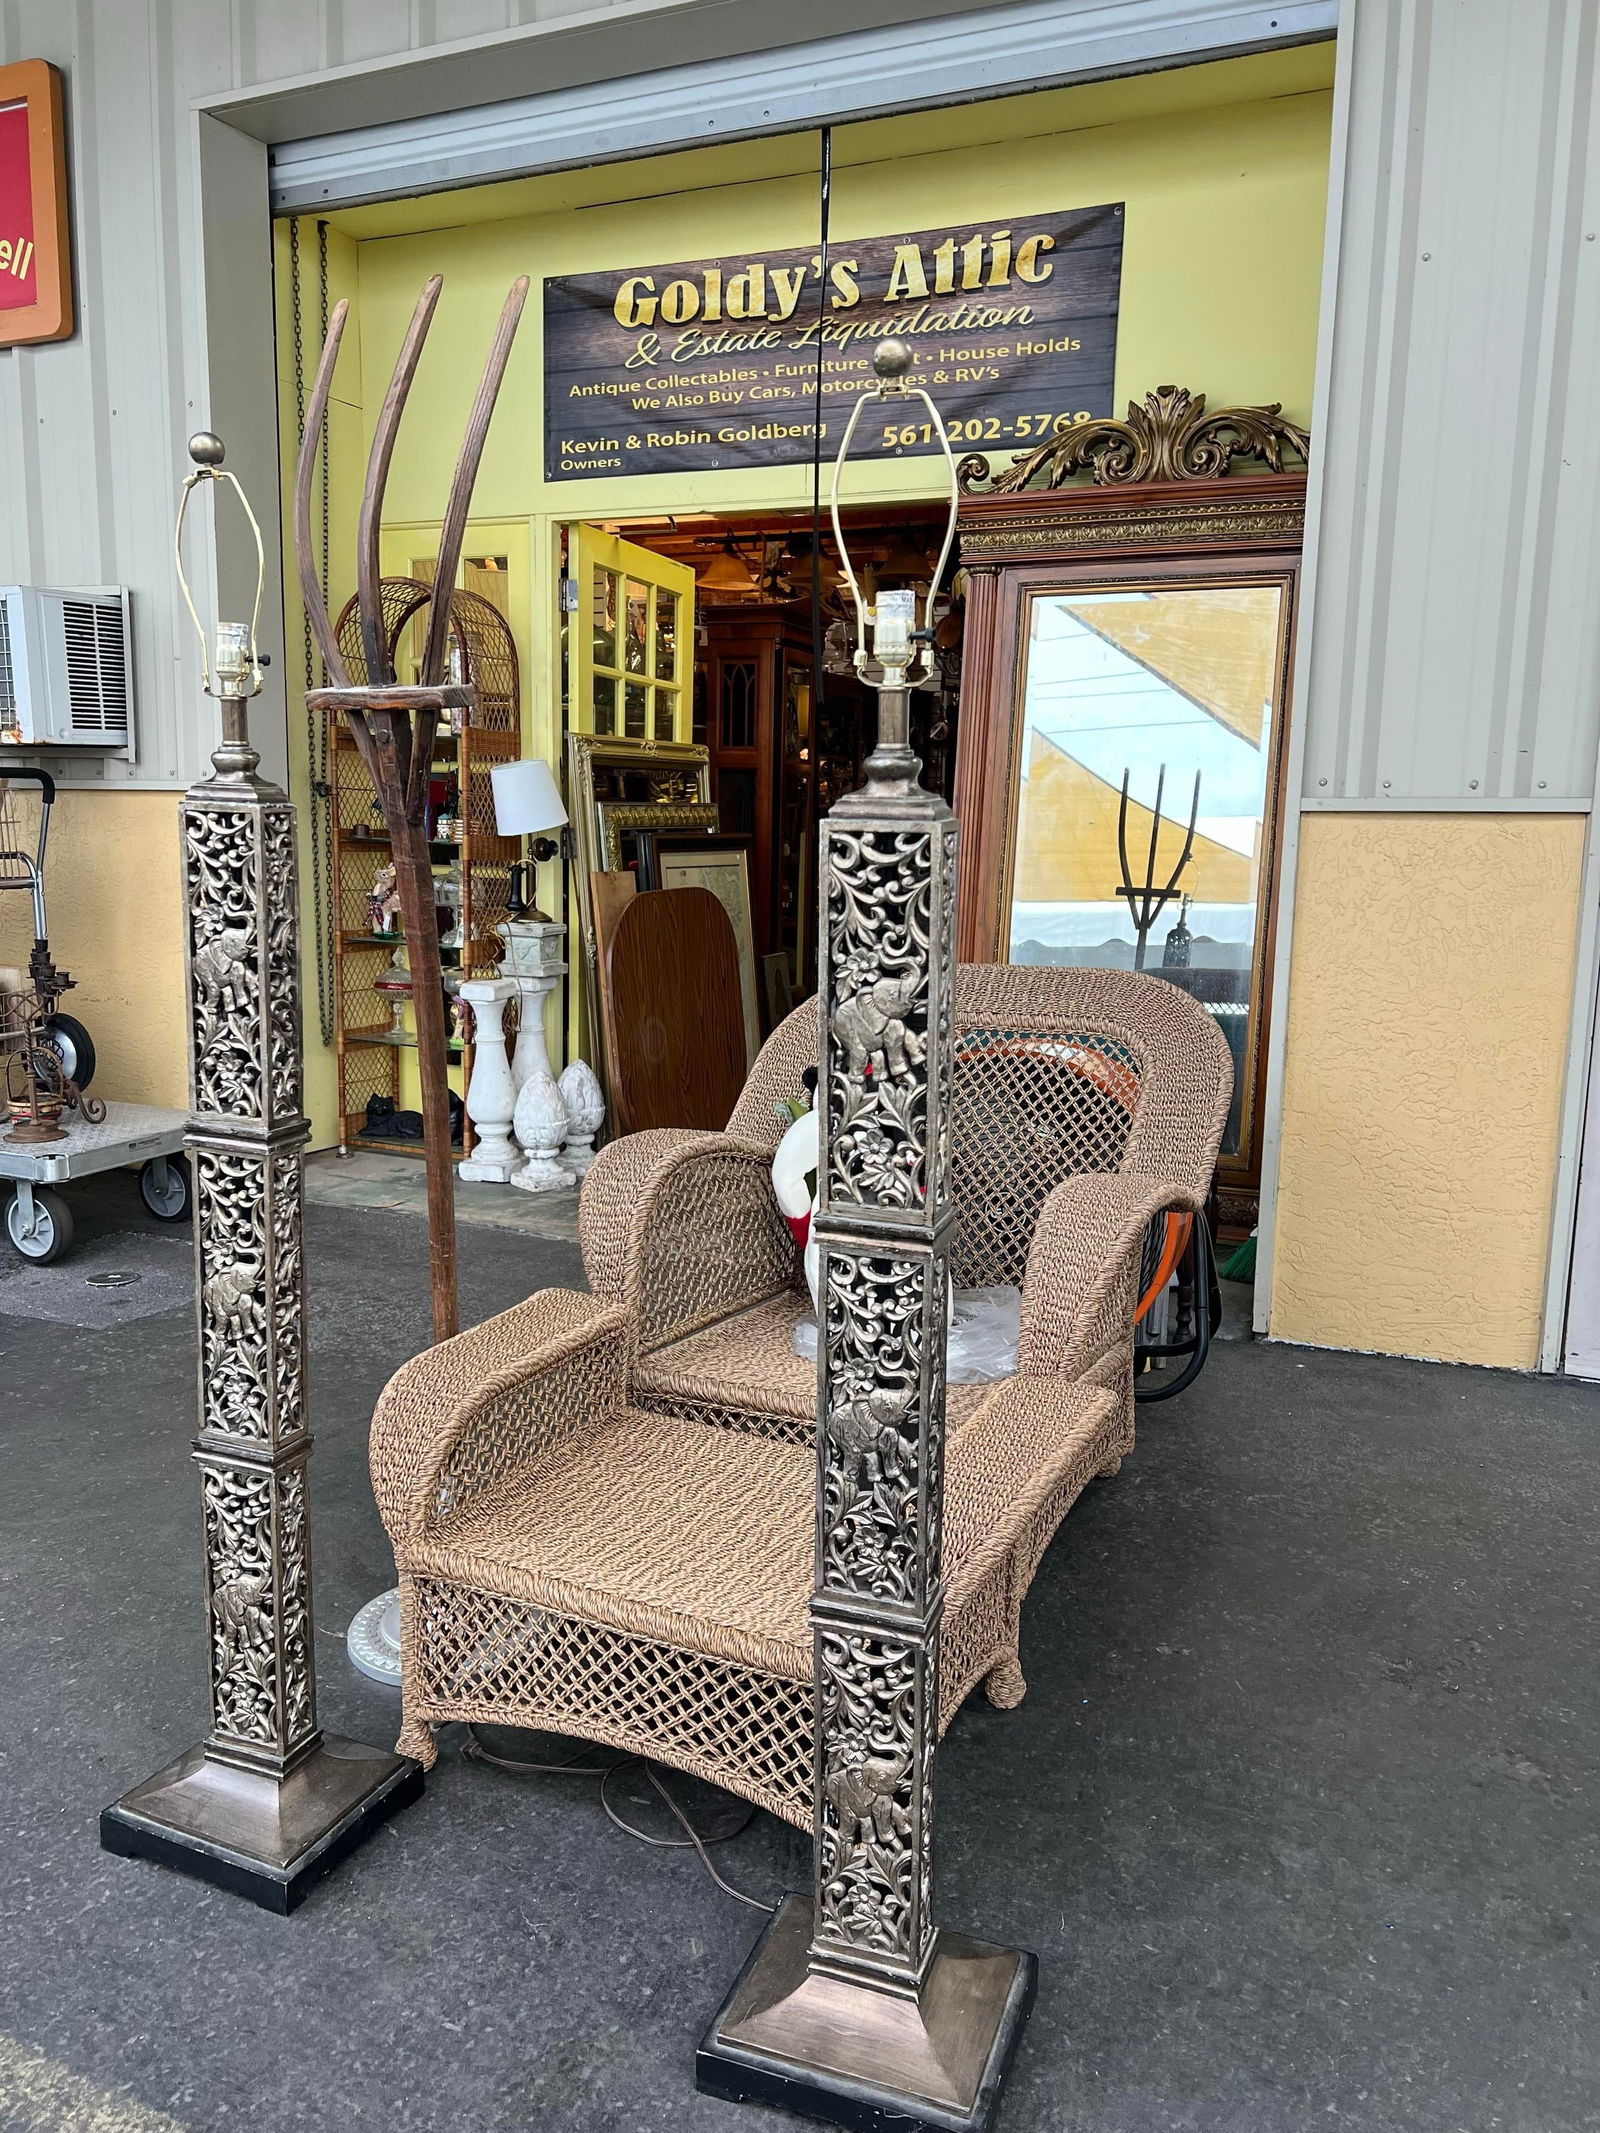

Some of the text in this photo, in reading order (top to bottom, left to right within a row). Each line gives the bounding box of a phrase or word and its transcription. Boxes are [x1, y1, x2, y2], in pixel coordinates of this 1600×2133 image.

[613, 229, 1055, 328] Goldy's Attic
[625, 303, 1034, 369] & Estate Liquidation
[569, 380, 640, 397] Antique
[645, 367, 758, 391] Collectables
[774, 357, 869, 378] Furniture
[940, 344, 1009, 362] House
[1016, 336, 1081, 356] Holds
[632, 365, 1000, 410] We Also Buy Cars, Motorcyles & RV's
[560, 421, 827, 455] Kevin & Robin Goldberg
[560, 457, 621, 471] Owners
